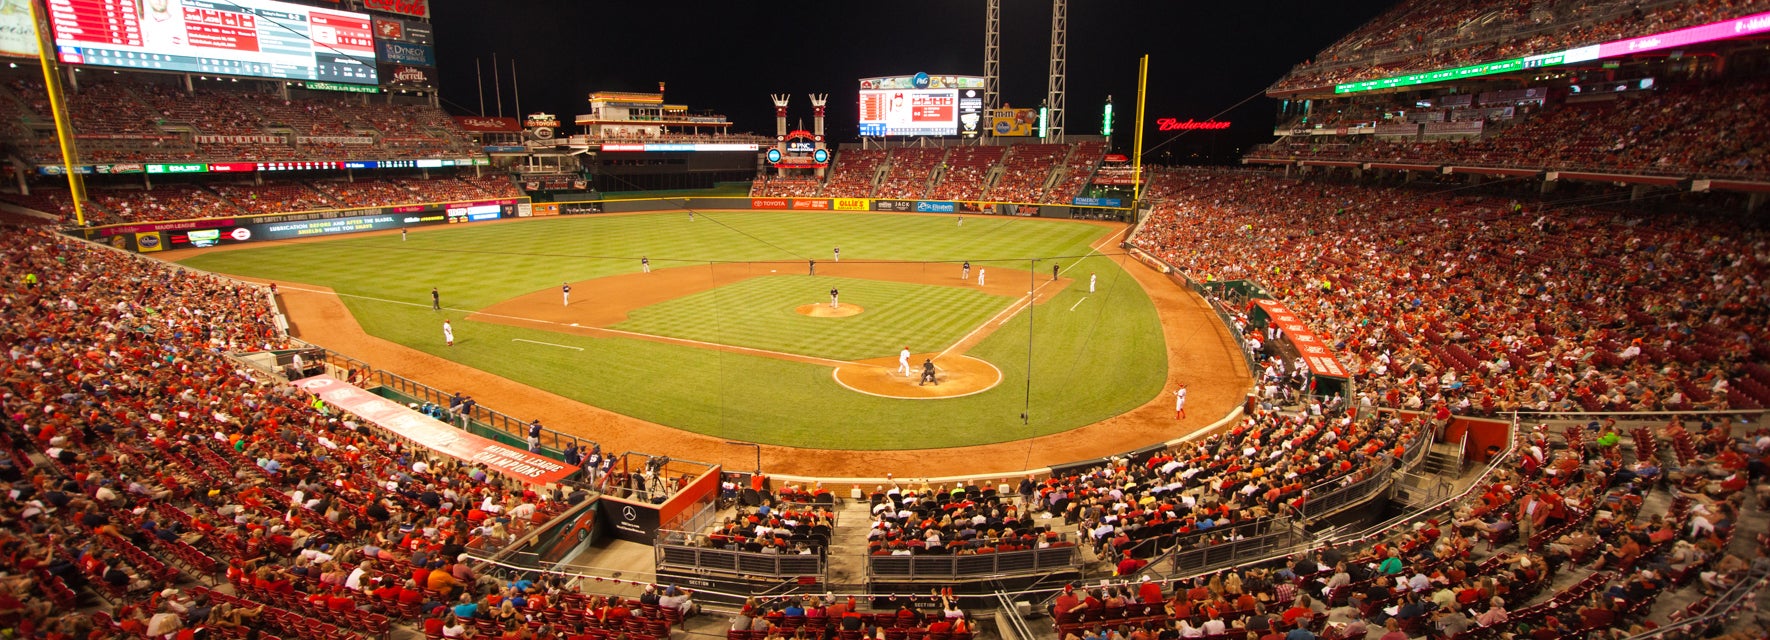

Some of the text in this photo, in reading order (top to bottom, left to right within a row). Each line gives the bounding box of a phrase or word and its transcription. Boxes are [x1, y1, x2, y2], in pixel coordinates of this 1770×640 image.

[394, 45, 425, 56] DYNEGY
[391, 71, 427, 83] Morrell
[1157, 118, 1232, 131] Budweiser
[269, 223, 308, 232] LUBRICATION
[473, 451, 545, 478] CHAMPIONS
[483, 444, 564, 473] NATIONAL LEAGUE
